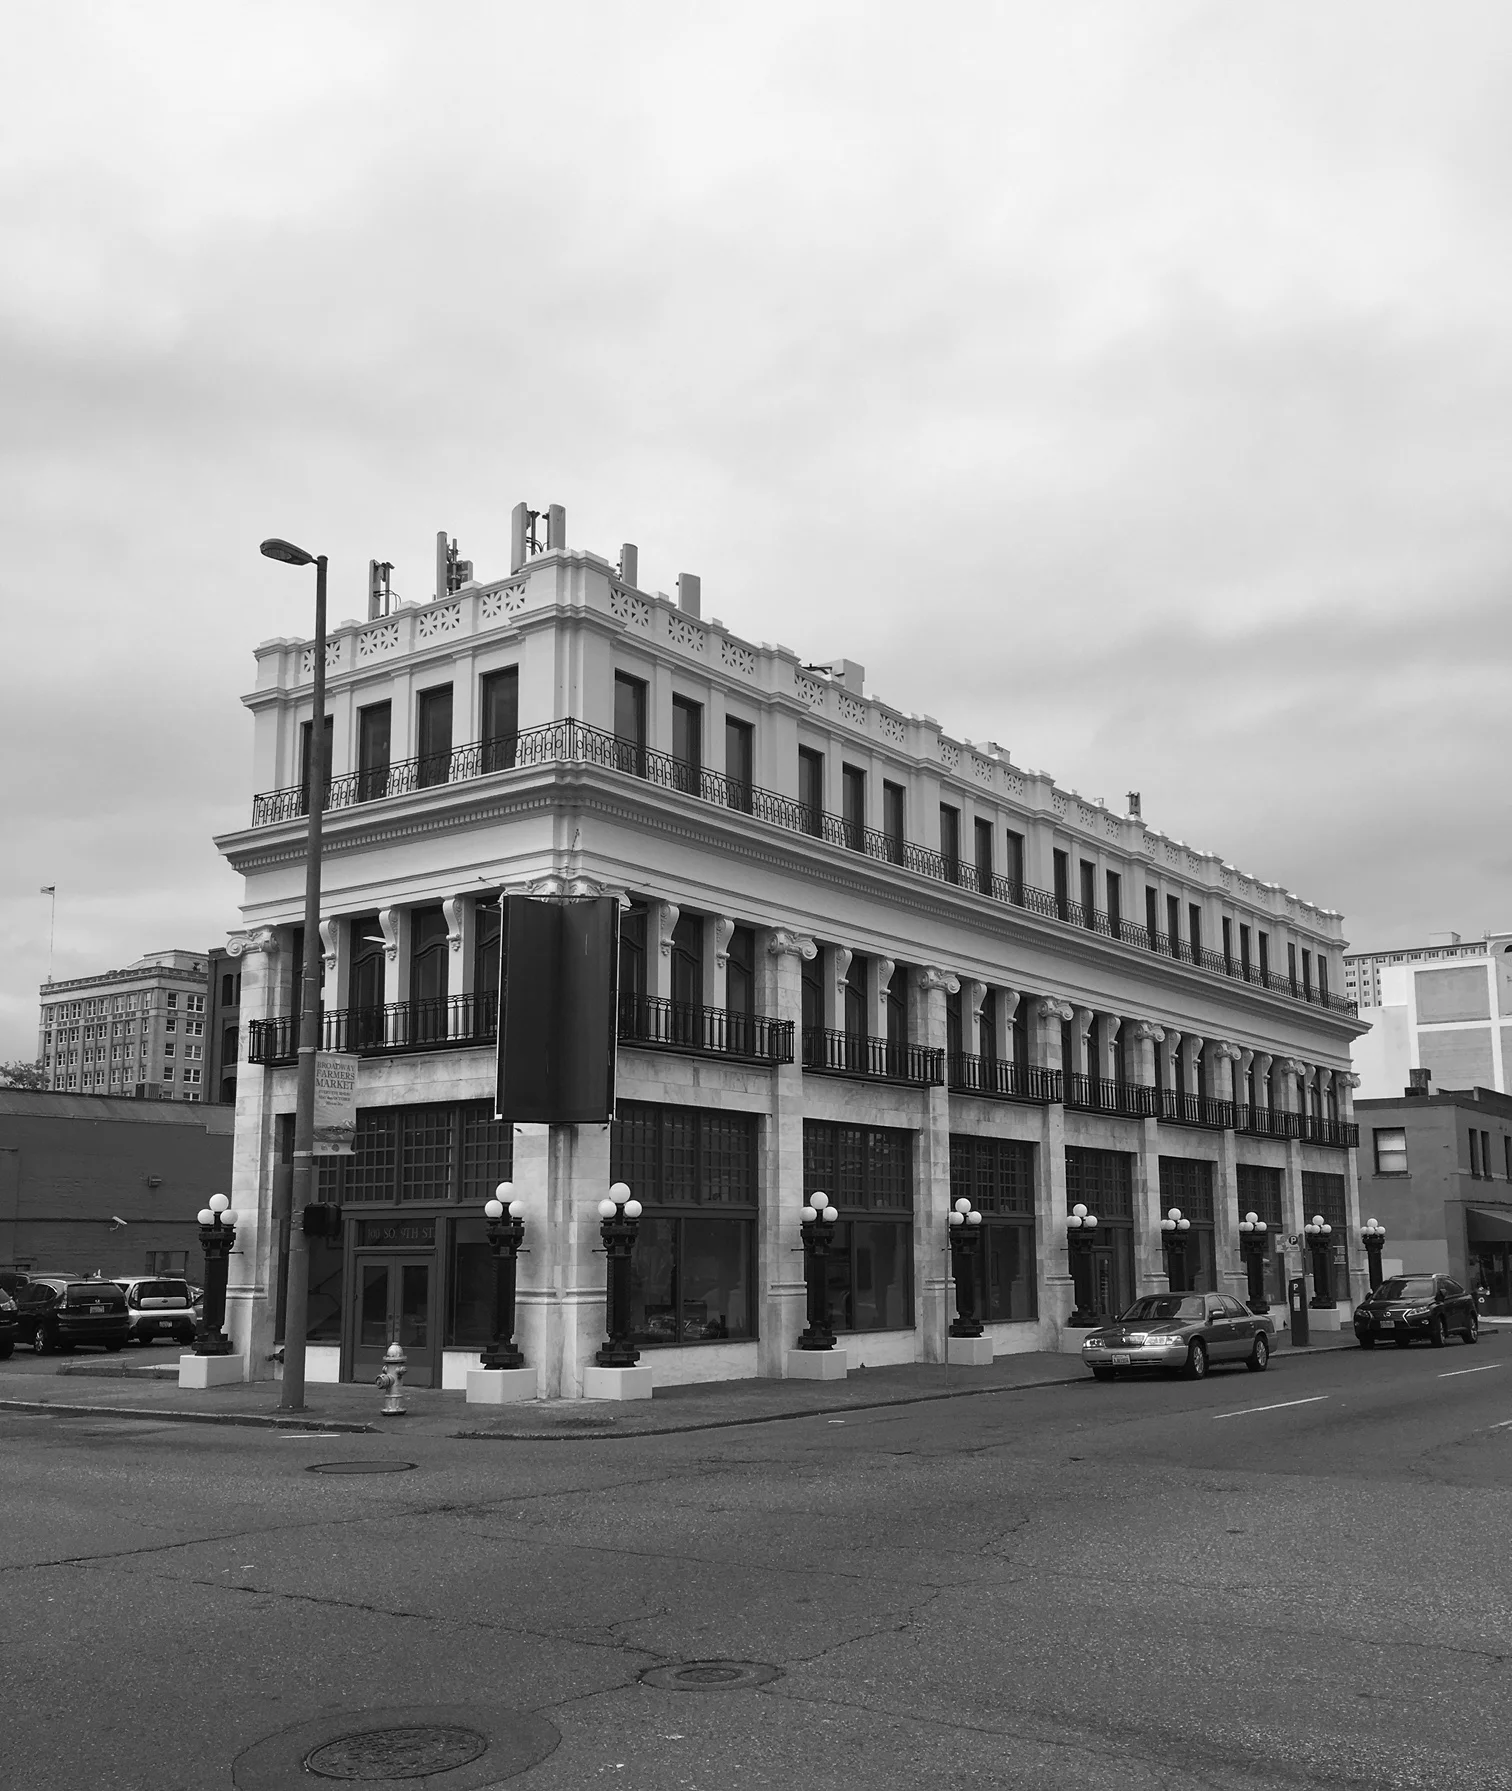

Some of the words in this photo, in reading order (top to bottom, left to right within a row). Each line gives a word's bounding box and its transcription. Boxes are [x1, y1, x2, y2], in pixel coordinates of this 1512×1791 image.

[317, 1061, 355, 1071] BROADWAY
[316, 1068, 355, 1080] FARMERS
[315, 1077, 354, 1090] MARKET
[400, 1227, 418, 1239] 9TH
[1291, 1236, 1297, 1244] P
[1293, 1283, 1299, 1291] P
